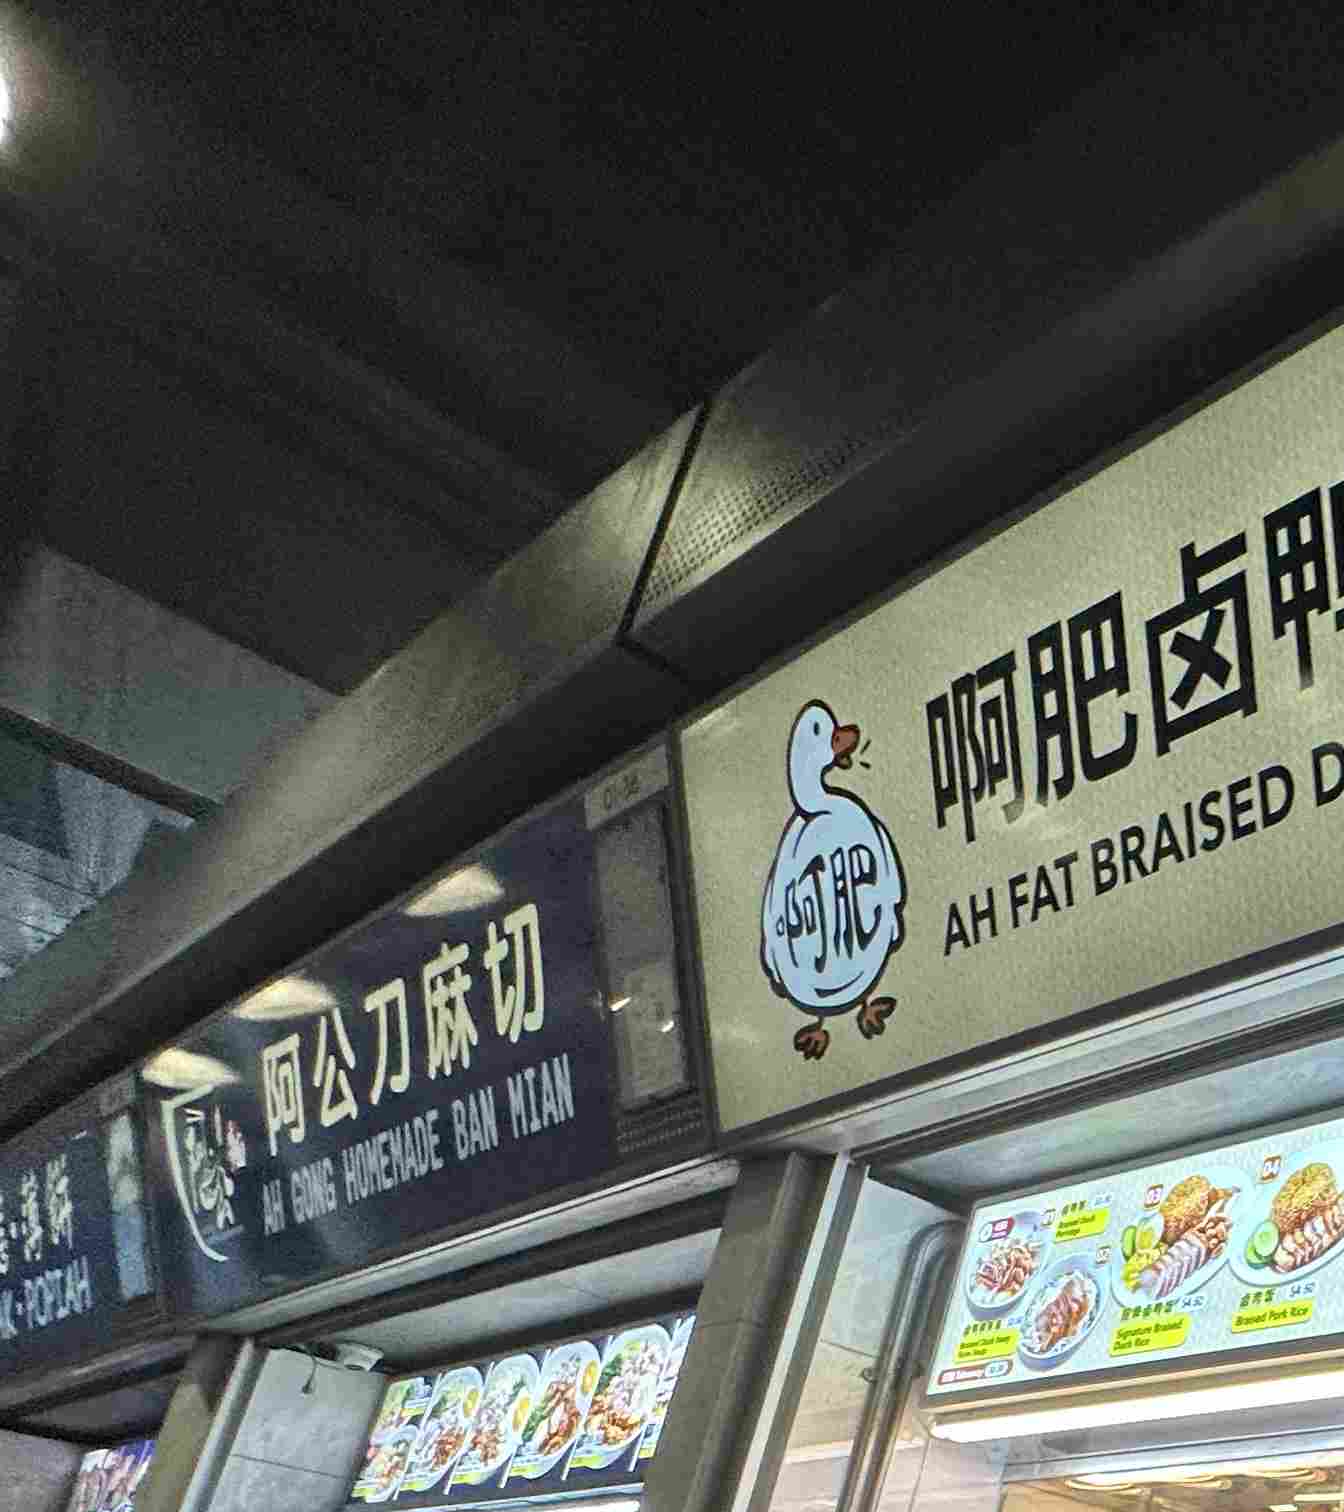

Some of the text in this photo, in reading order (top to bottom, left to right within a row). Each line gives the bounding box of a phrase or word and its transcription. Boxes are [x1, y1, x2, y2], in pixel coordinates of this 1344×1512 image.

[944, 887, 998, 956] AH
[1007, 851, 1078, 935] FAT
[1091, 765, 1295, 895] BRAISED
[263, 903, 544, 1157] 阿公刀麻切
[263, 1180, 286, 1236] AH
[290, 1158, 338, 1224] GONG
[342, 1109, 444, 1205] HOMEMADE
[451, 1086, 499, 1161] BAN
[507, 1053, 575, 1140] MIAN
